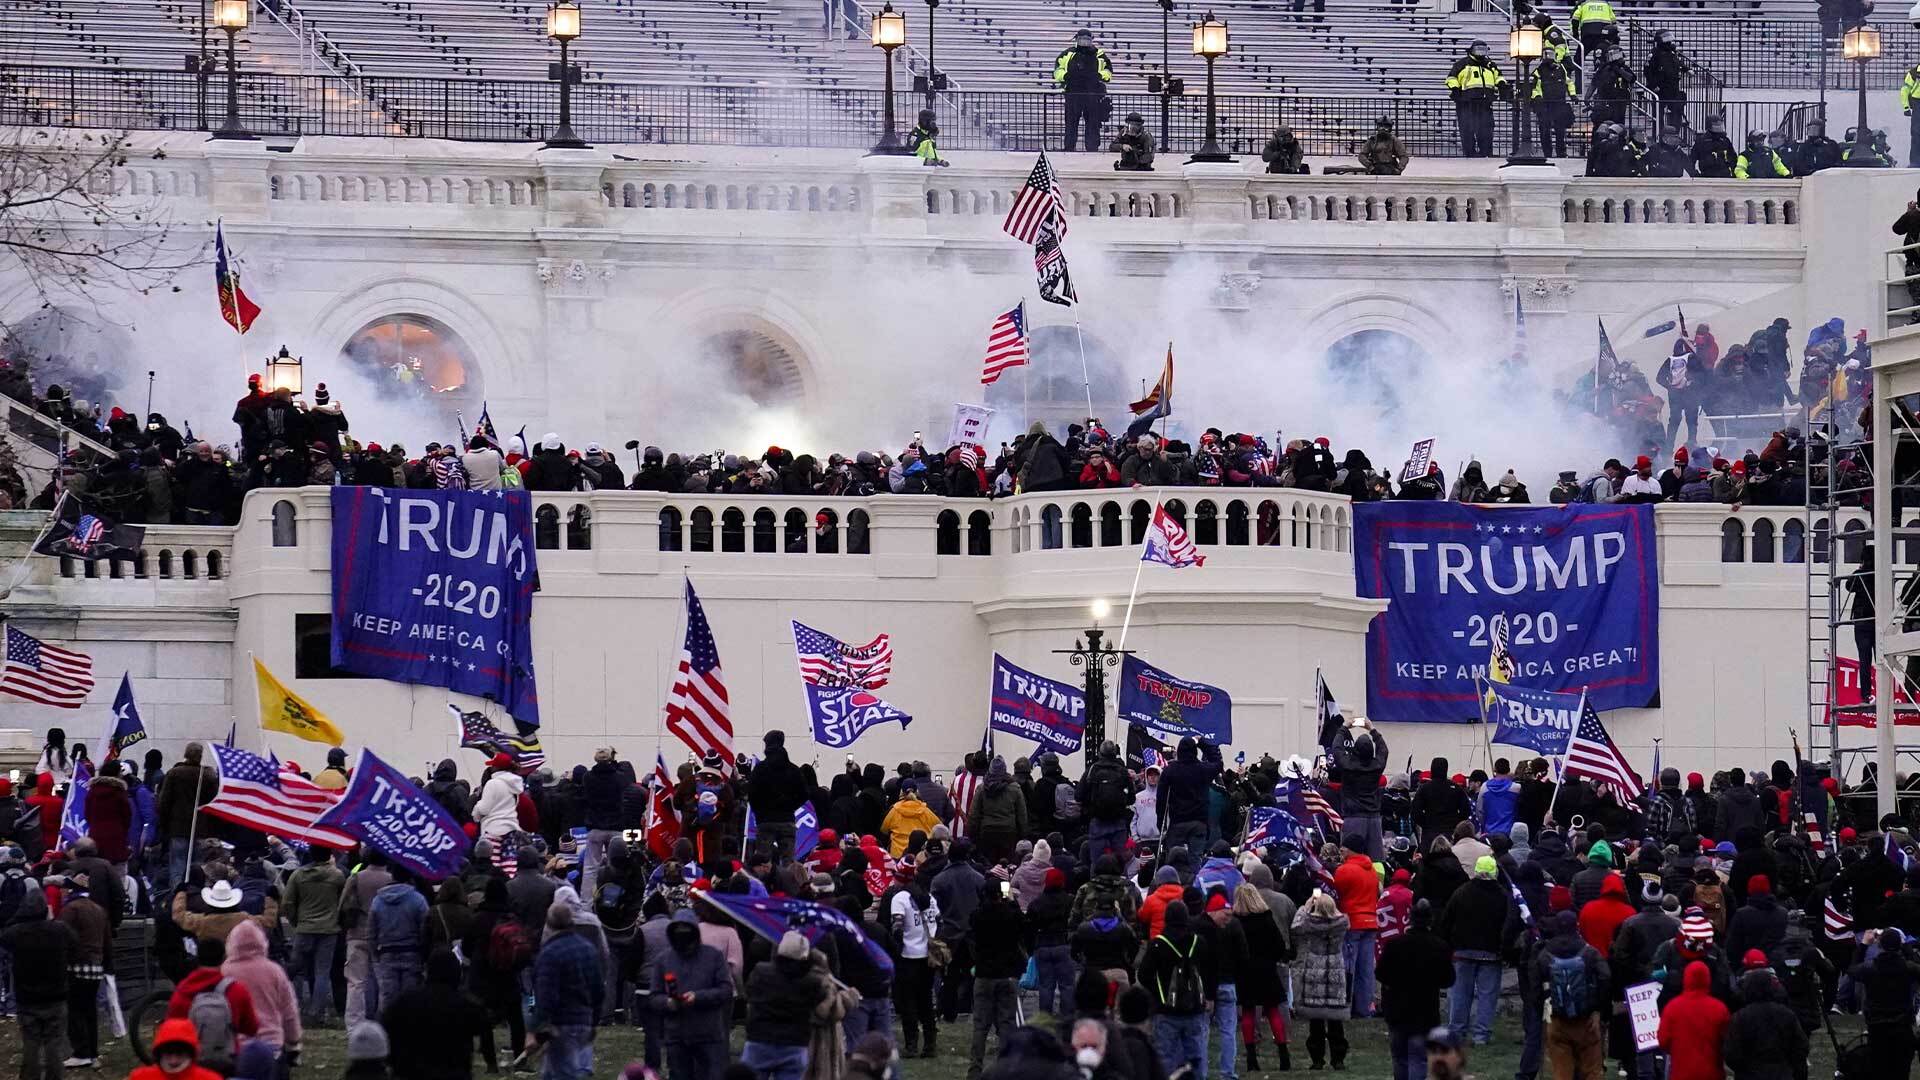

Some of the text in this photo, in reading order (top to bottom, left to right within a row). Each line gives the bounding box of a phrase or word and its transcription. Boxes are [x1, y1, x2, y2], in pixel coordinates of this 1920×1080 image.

[1408, 451, 1419, 472] 2020
[1416, 441, 1431, 475] TRUMP
[1162, 515, 1197, 561] RUM
[1388, 531, 1626, 595] TRUMP
[352, 612, 402, 636] KEEP
[409, 624, 486, 651] AMECA
[840, 643, 879, 660] GUNS
[1396, 647, 1638, 680] KEEP AMICA GREAT!
[818, 689, 842, 698] FIGHT
[999, 665, 1086, 717] TRUMP
[1136, 674, 1212, 709] TRUMP
[1131, 711, 1152, 722] KEEP
[370, 775, 456, 854] TRUMP
[374, 814, 424, 850] -2020-
[1629, 990, 1653, 1003] KEEP
[1634, 1012, 1647, 1023] TO
